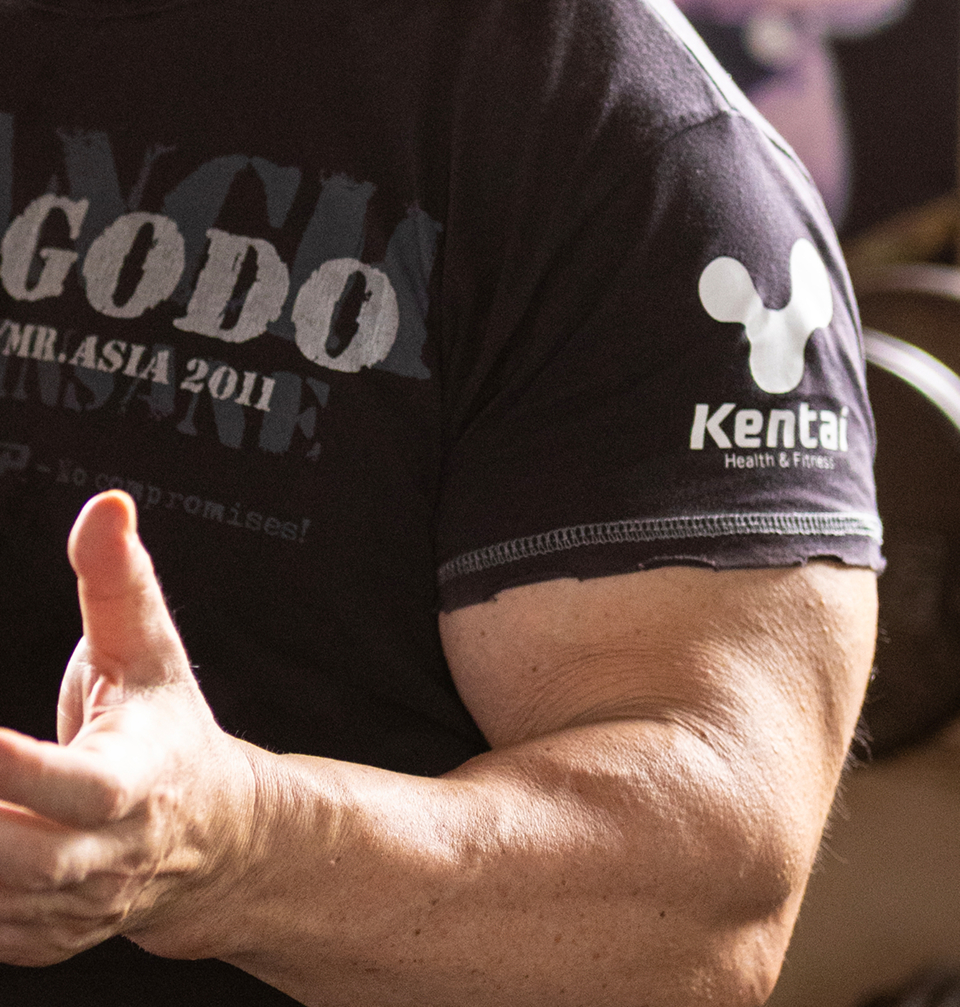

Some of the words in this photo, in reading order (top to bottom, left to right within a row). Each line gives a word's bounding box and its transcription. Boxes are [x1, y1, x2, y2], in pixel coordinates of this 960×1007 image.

[179, 357, 277, 413] 2011
[690, 402, 849, 452] Kentai
[724, 452, 775, 469] Health
[779, 451, 790, 469] &
[792, 452, 836, 470] Fitness
